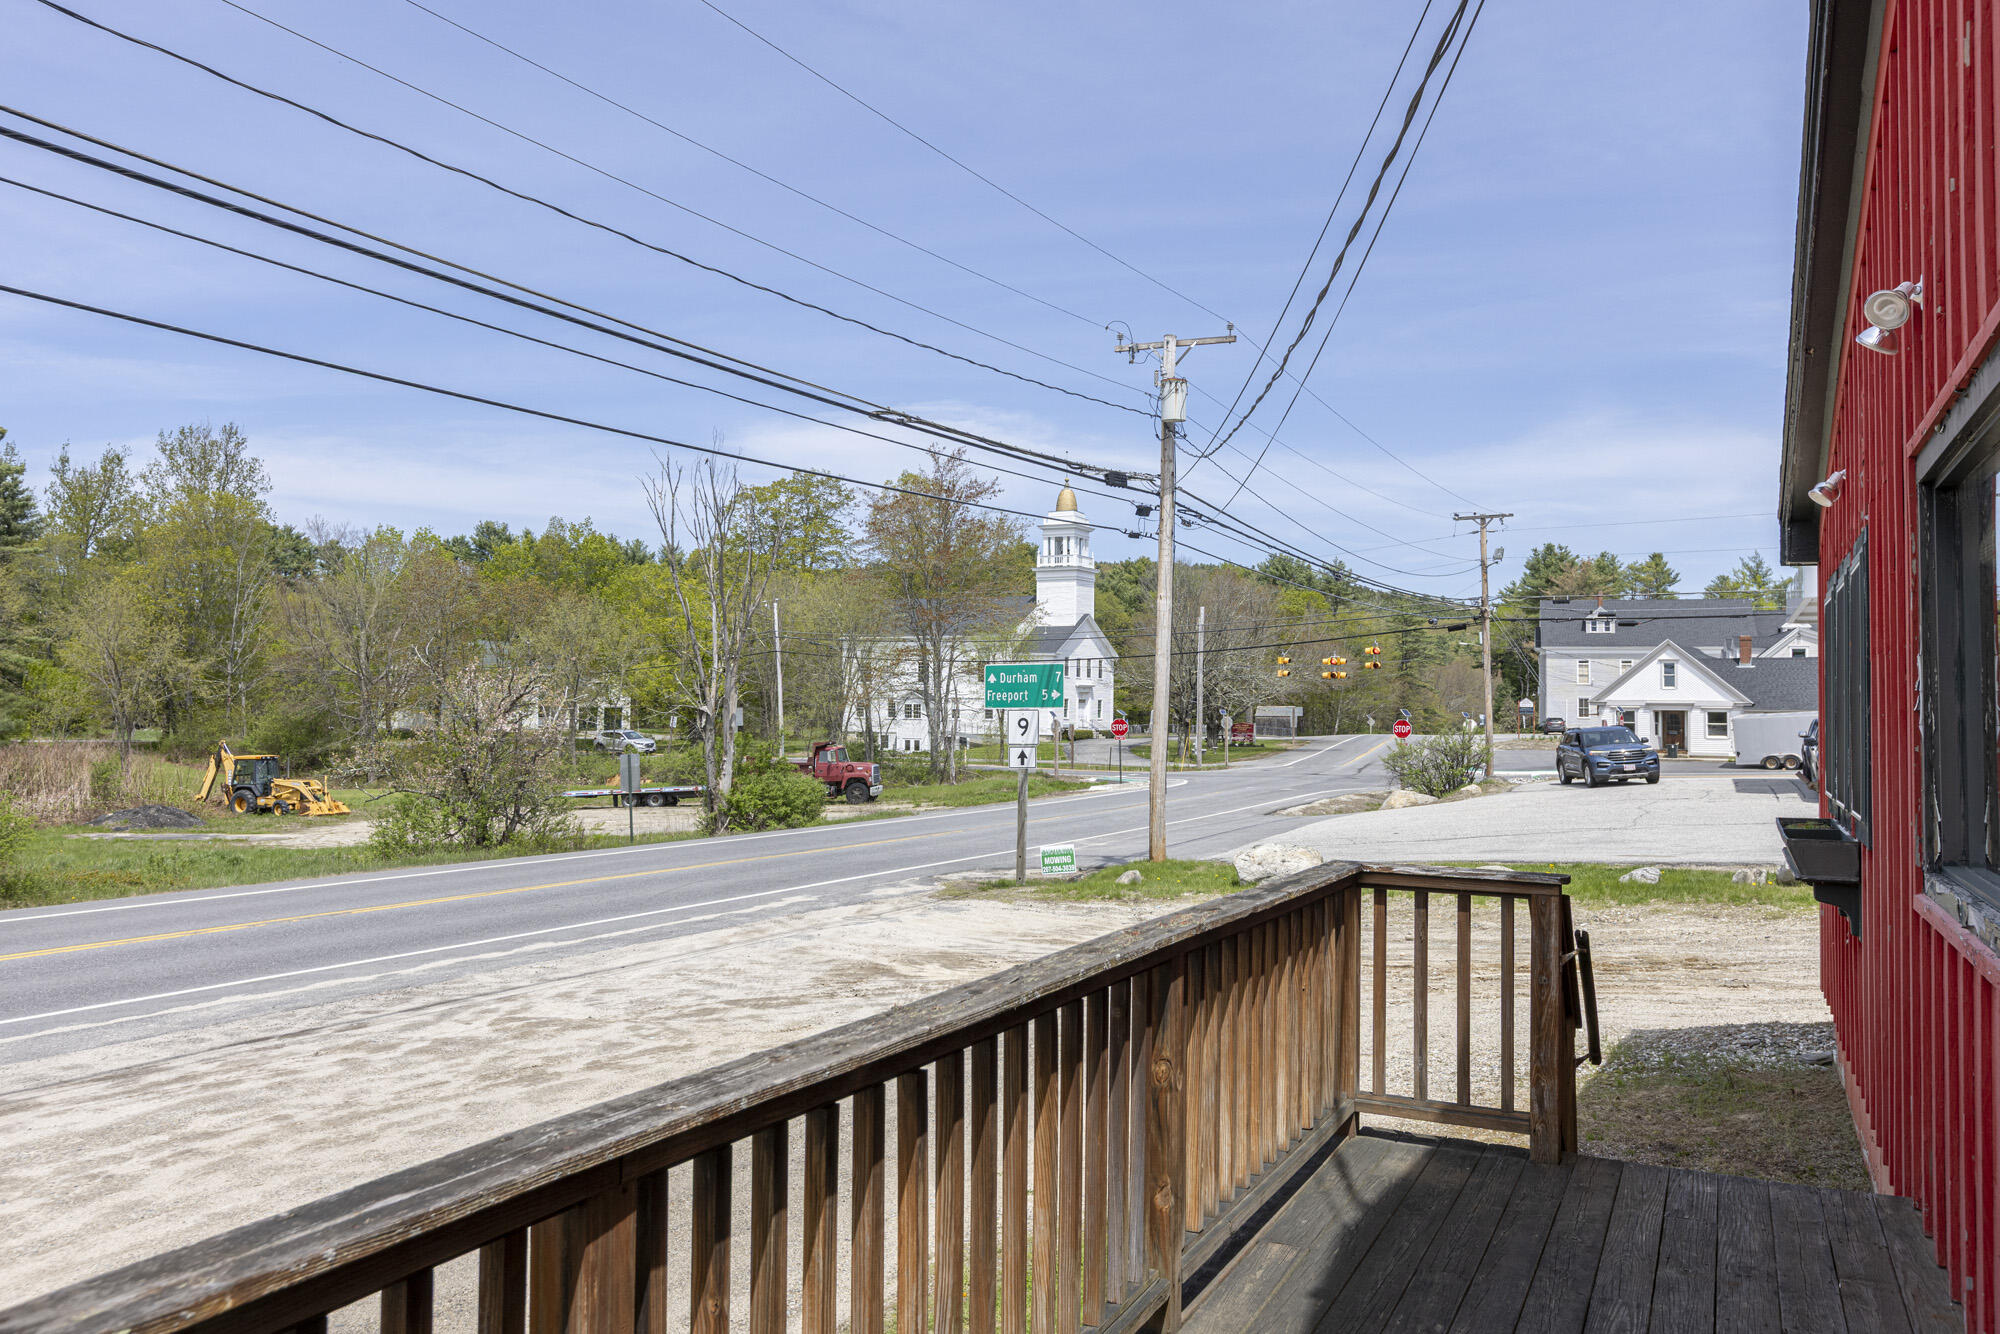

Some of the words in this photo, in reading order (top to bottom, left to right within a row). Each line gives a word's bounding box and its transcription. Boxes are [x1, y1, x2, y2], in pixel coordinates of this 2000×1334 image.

[1000, 672, 1037, 683] Durham
[1055, 671, 1061, 683] 7
[987, 690, 1028, 703] Freeport
[1042, 689, 1048, 700] 5
[1017, 717, 1029, 736] 9
[1395, 725, 1410, 733] STOP
[1044, 856, 1071, 864] MOWING
